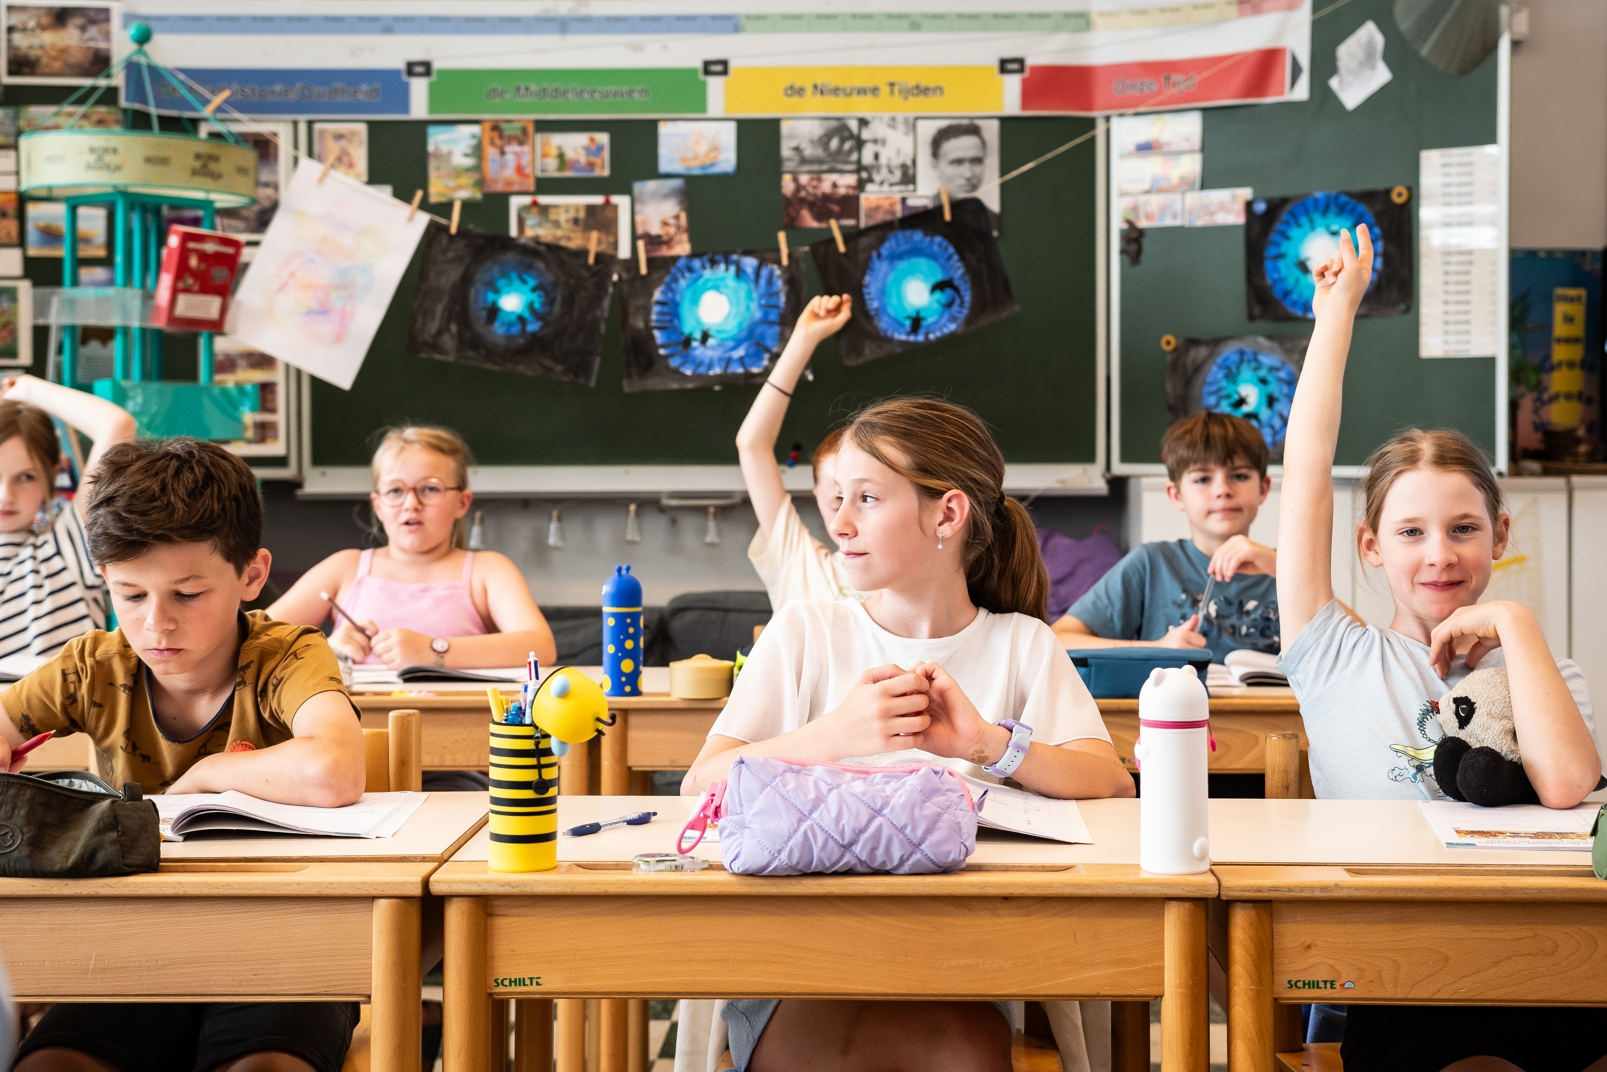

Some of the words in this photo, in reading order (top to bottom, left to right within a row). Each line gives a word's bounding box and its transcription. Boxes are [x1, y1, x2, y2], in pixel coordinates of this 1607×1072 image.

[486, 84, 510, 100] de
[514, 83, 650, 100] Middeleeuwen
[783, 83, 807, 98] de
[811, 82, 881, 98] Nieuwe
[886, 81, 945, 101] Tijden
[1113, 77, 1157, 96] Onze
[493, 976, 543, 988] SCHILTE
[1286, 979, 1337, 990] SCHILTE
